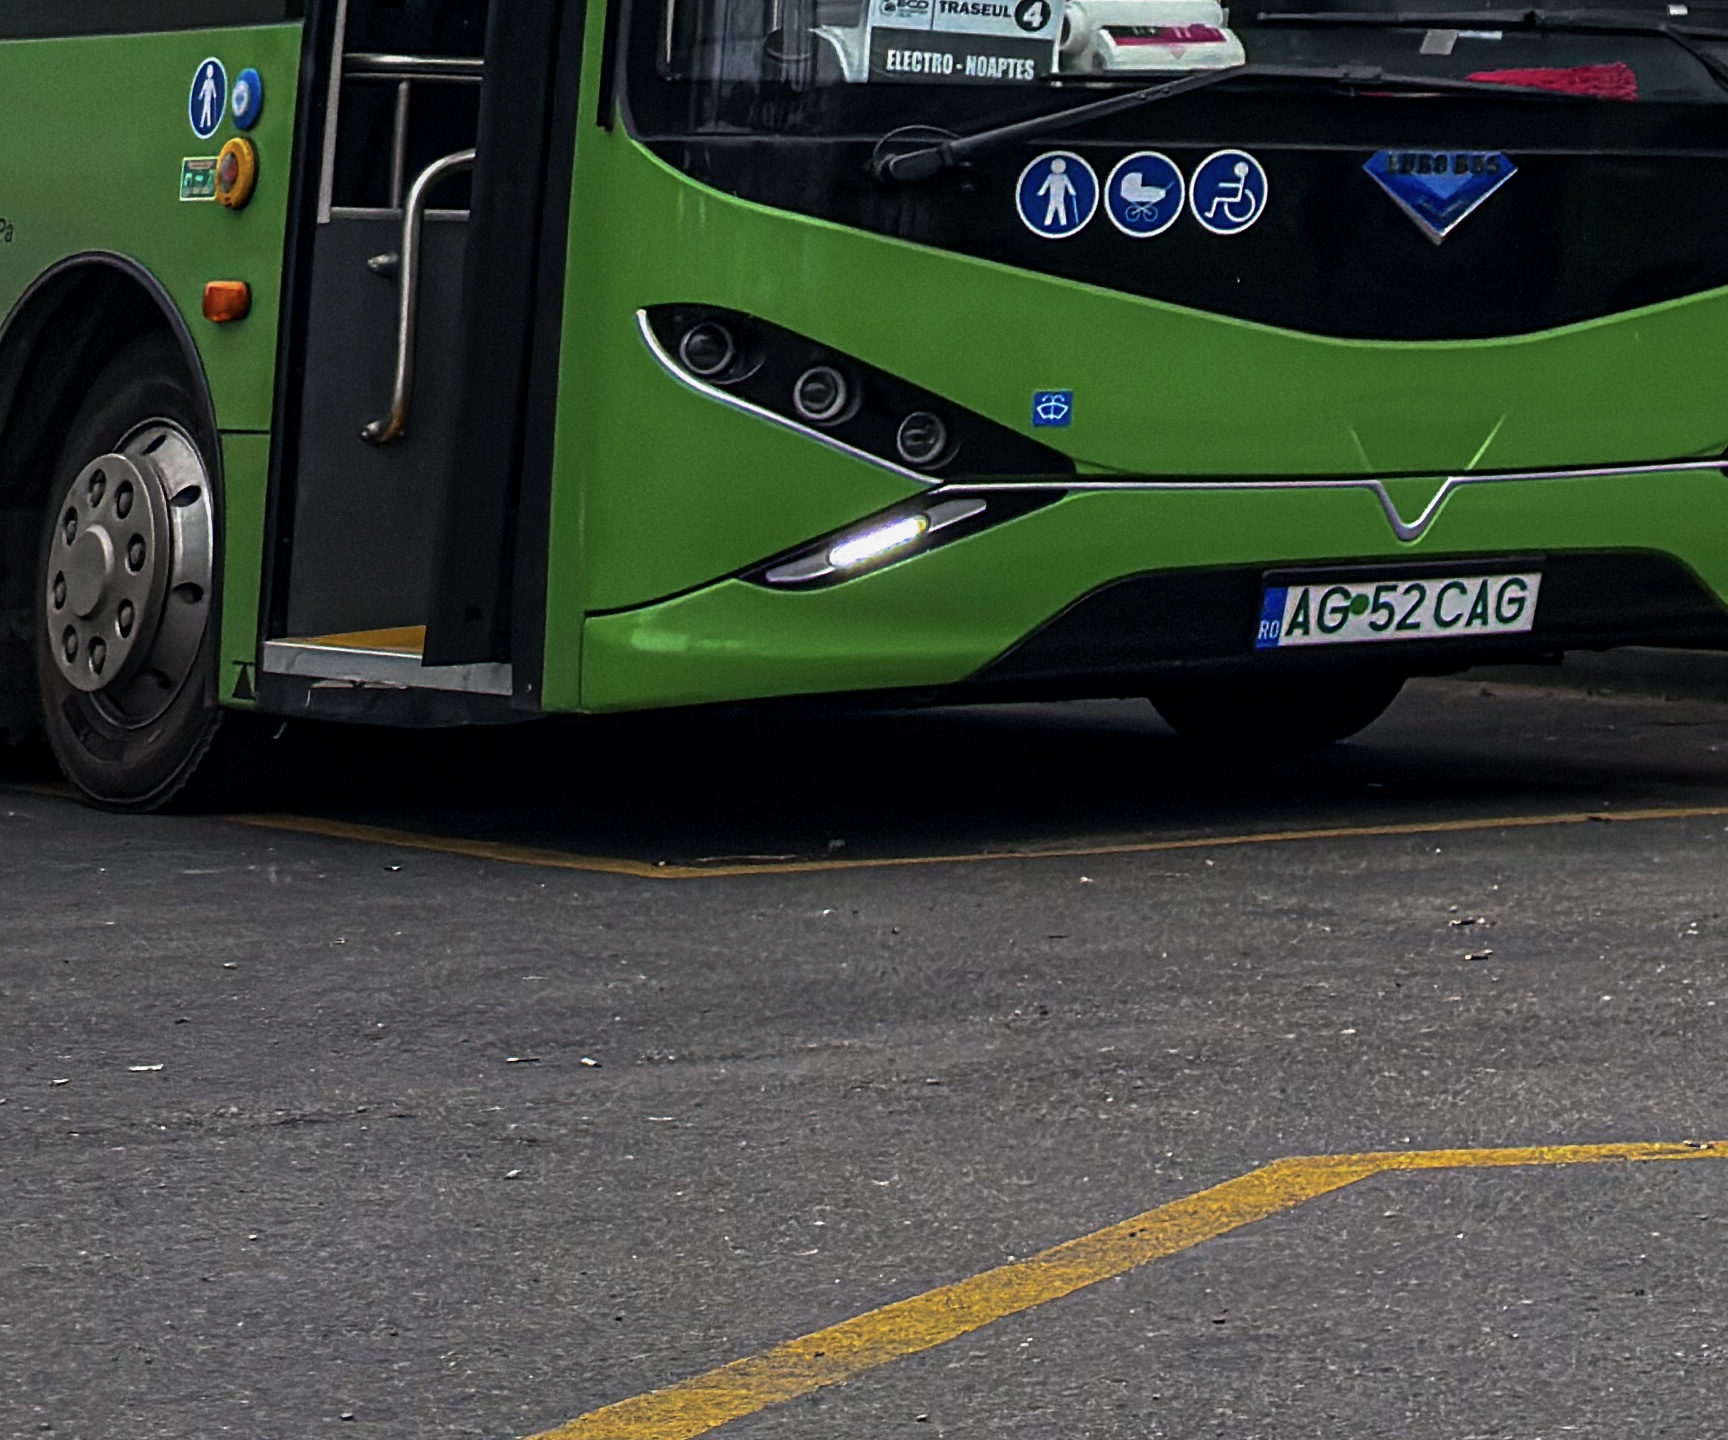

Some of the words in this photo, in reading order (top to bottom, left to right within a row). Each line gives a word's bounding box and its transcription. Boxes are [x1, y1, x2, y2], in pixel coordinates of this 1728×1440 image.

[938, 0, 1013, 19] TRASEUL
[1021, 1, 1045, 29] 4
[885, 48, 954, 75] ELECTRO
[964, 54, 1036, 81] NOAPTES
[1284, 585, 1353, 637] AG
[1368, 582, 1428, 632] 52
[1433, 576, 1530, 629] CAG
[1257, 619, 1281, 641] RO
